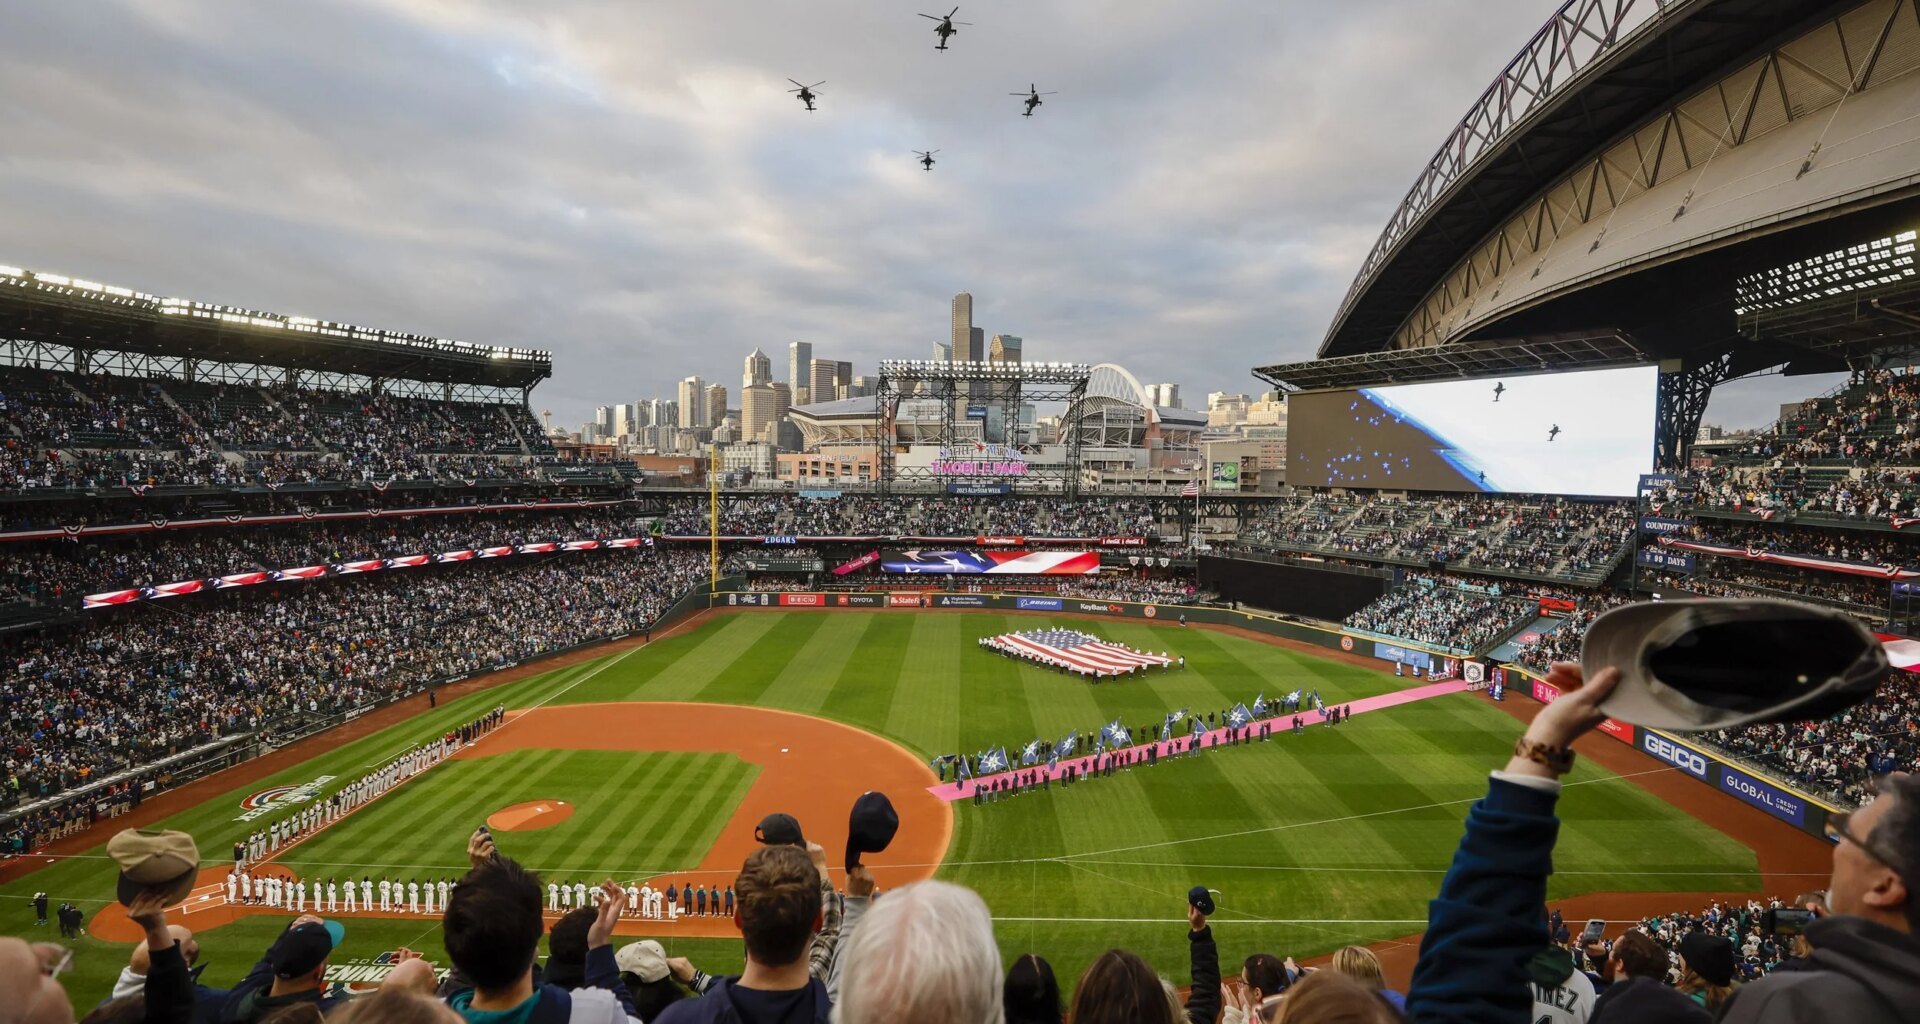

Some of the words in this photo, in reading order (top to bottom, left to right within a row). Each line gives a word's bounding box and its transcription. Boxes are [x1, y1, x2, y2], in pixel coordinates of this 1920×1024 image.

[994, 462, 1028, 475] PARK
[1667, 556, 1686, 567] DAYS
[1080, 603, 1108, 611] KeyBank
[1344, 639, 1351, 647] 76
[346, 709, 359, 719] ROOT
[360, 705, 375, 714] SPORTS
[1645, 734, 1706, 776] GEICO
[1727, 775, 1773, 806] GLOBAL
[1776, 798, 1797, 811] CREDIT
[1775, 804, 1795, 816] UNION
